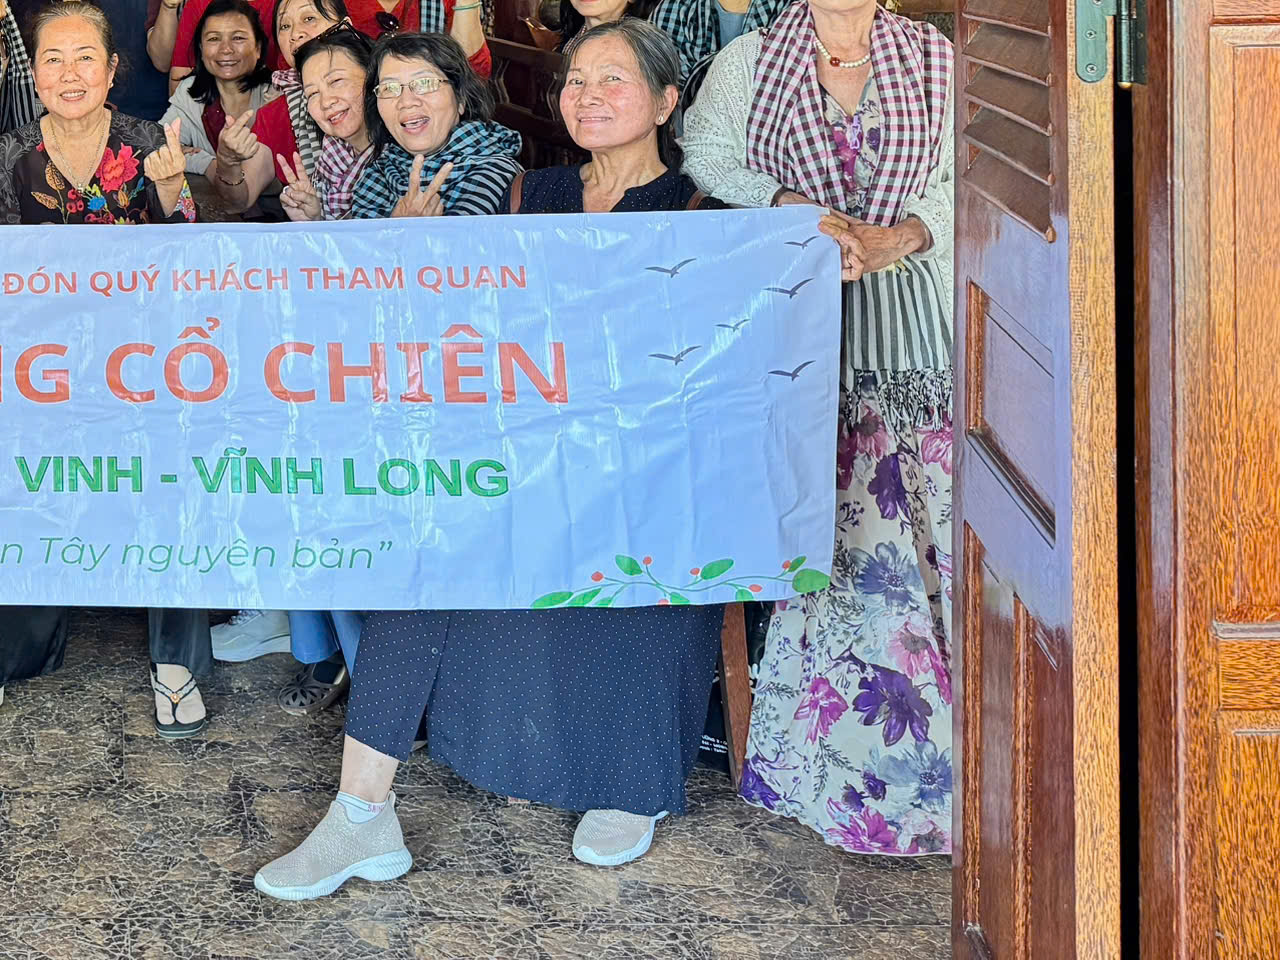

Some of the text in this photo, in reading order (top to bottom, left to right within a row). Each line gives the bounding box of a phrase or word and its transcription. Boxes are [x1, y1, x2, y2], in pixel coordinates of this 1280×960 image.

[2, 265, 78, 295] ĐÓN
[89, 264, 160, 298] QUÝ
[173, 263, 288, 292] KHÁCH
[300, 266, 404, 291] THAM
[417, 265, 527, 294] QUAN
[105, 317, 229, 403] CỔ
[264, 324, 568, 404] CHIÊN
[15, 456, 142, 493] VINH
[160, 473, 178, 484] -
[192, 447, 322, 494] VĨNH
[343, 458, 510, 497] LONG
[40, 536, 110, 571] Tây
[122, 539, 276, 573] nguyên
